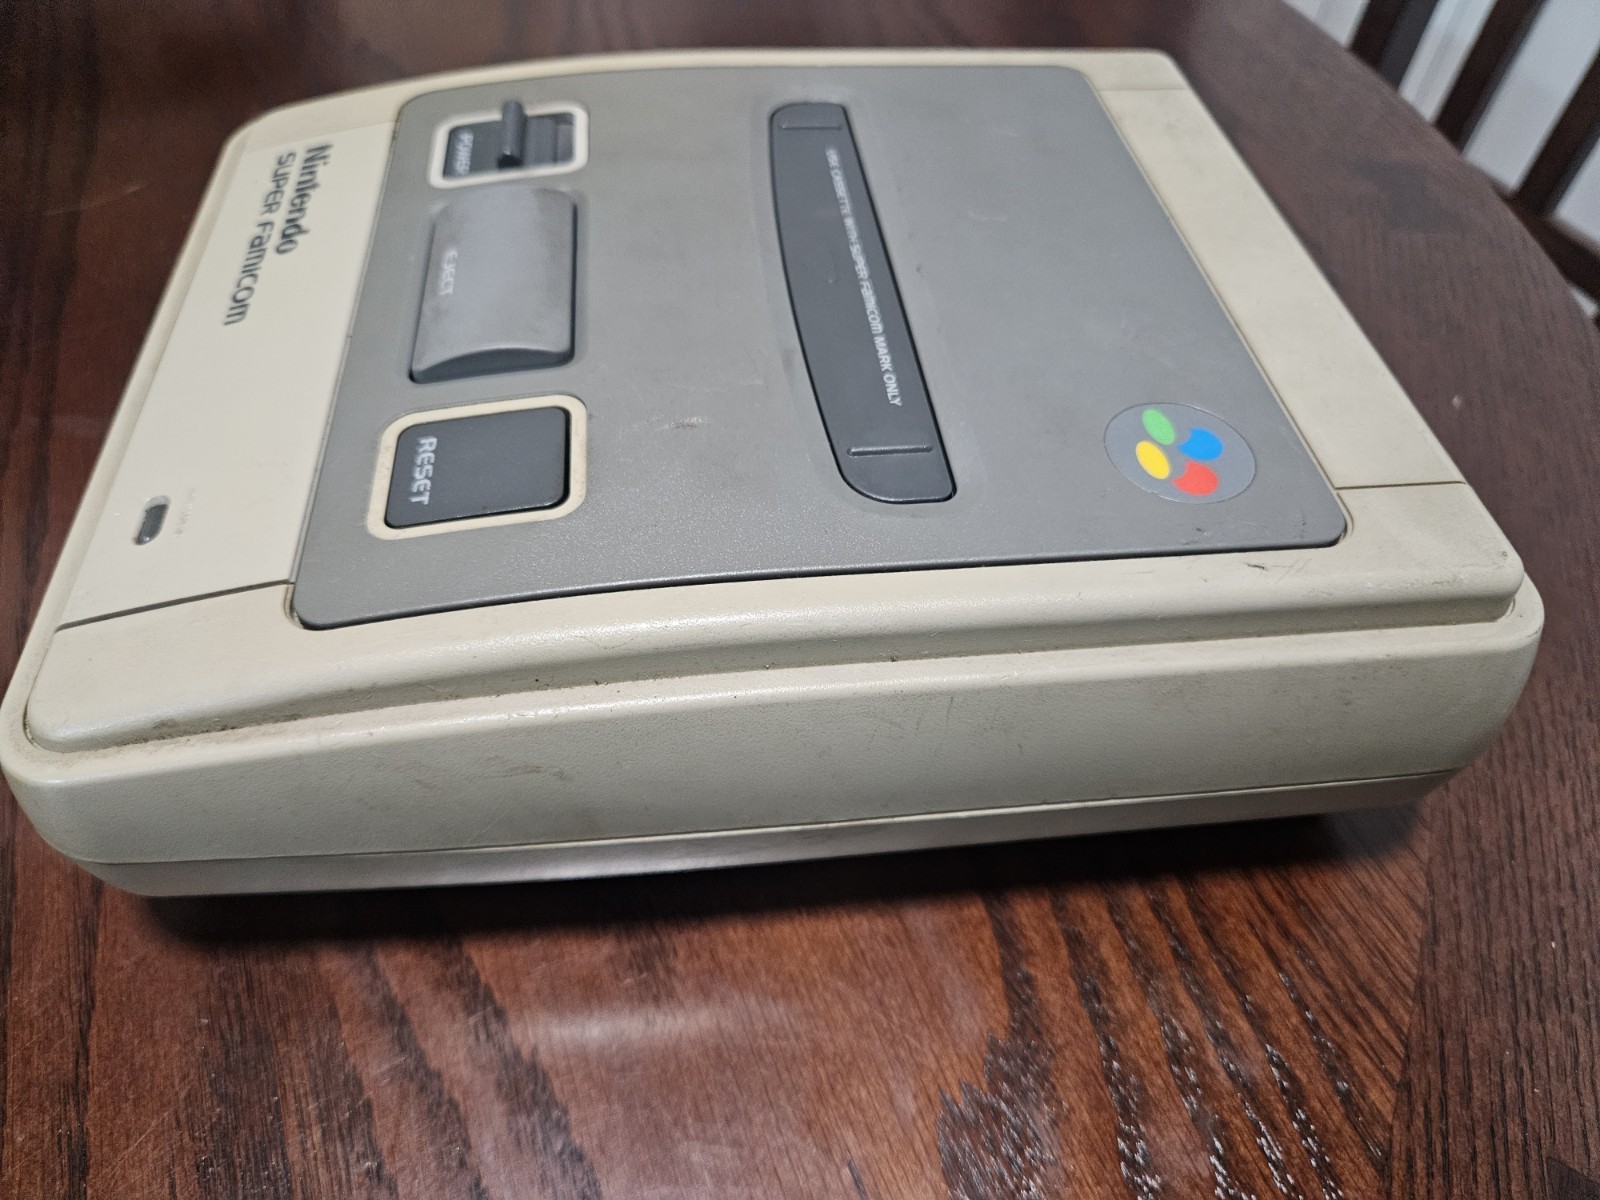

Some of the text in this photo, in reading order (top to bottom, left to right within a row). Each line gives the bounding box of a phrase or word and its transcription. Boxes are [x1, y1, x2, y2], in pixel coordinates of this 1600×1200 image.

[261, 151, 297, 215] SUPER
[275, 144, 333, 255] Nintendo
[849, 243, 869, 279] SUPER
[874, 335, 893, 371] MARK
[883, 372, 903, 407] ONLY
[409, 435, 438, 505] RESET
